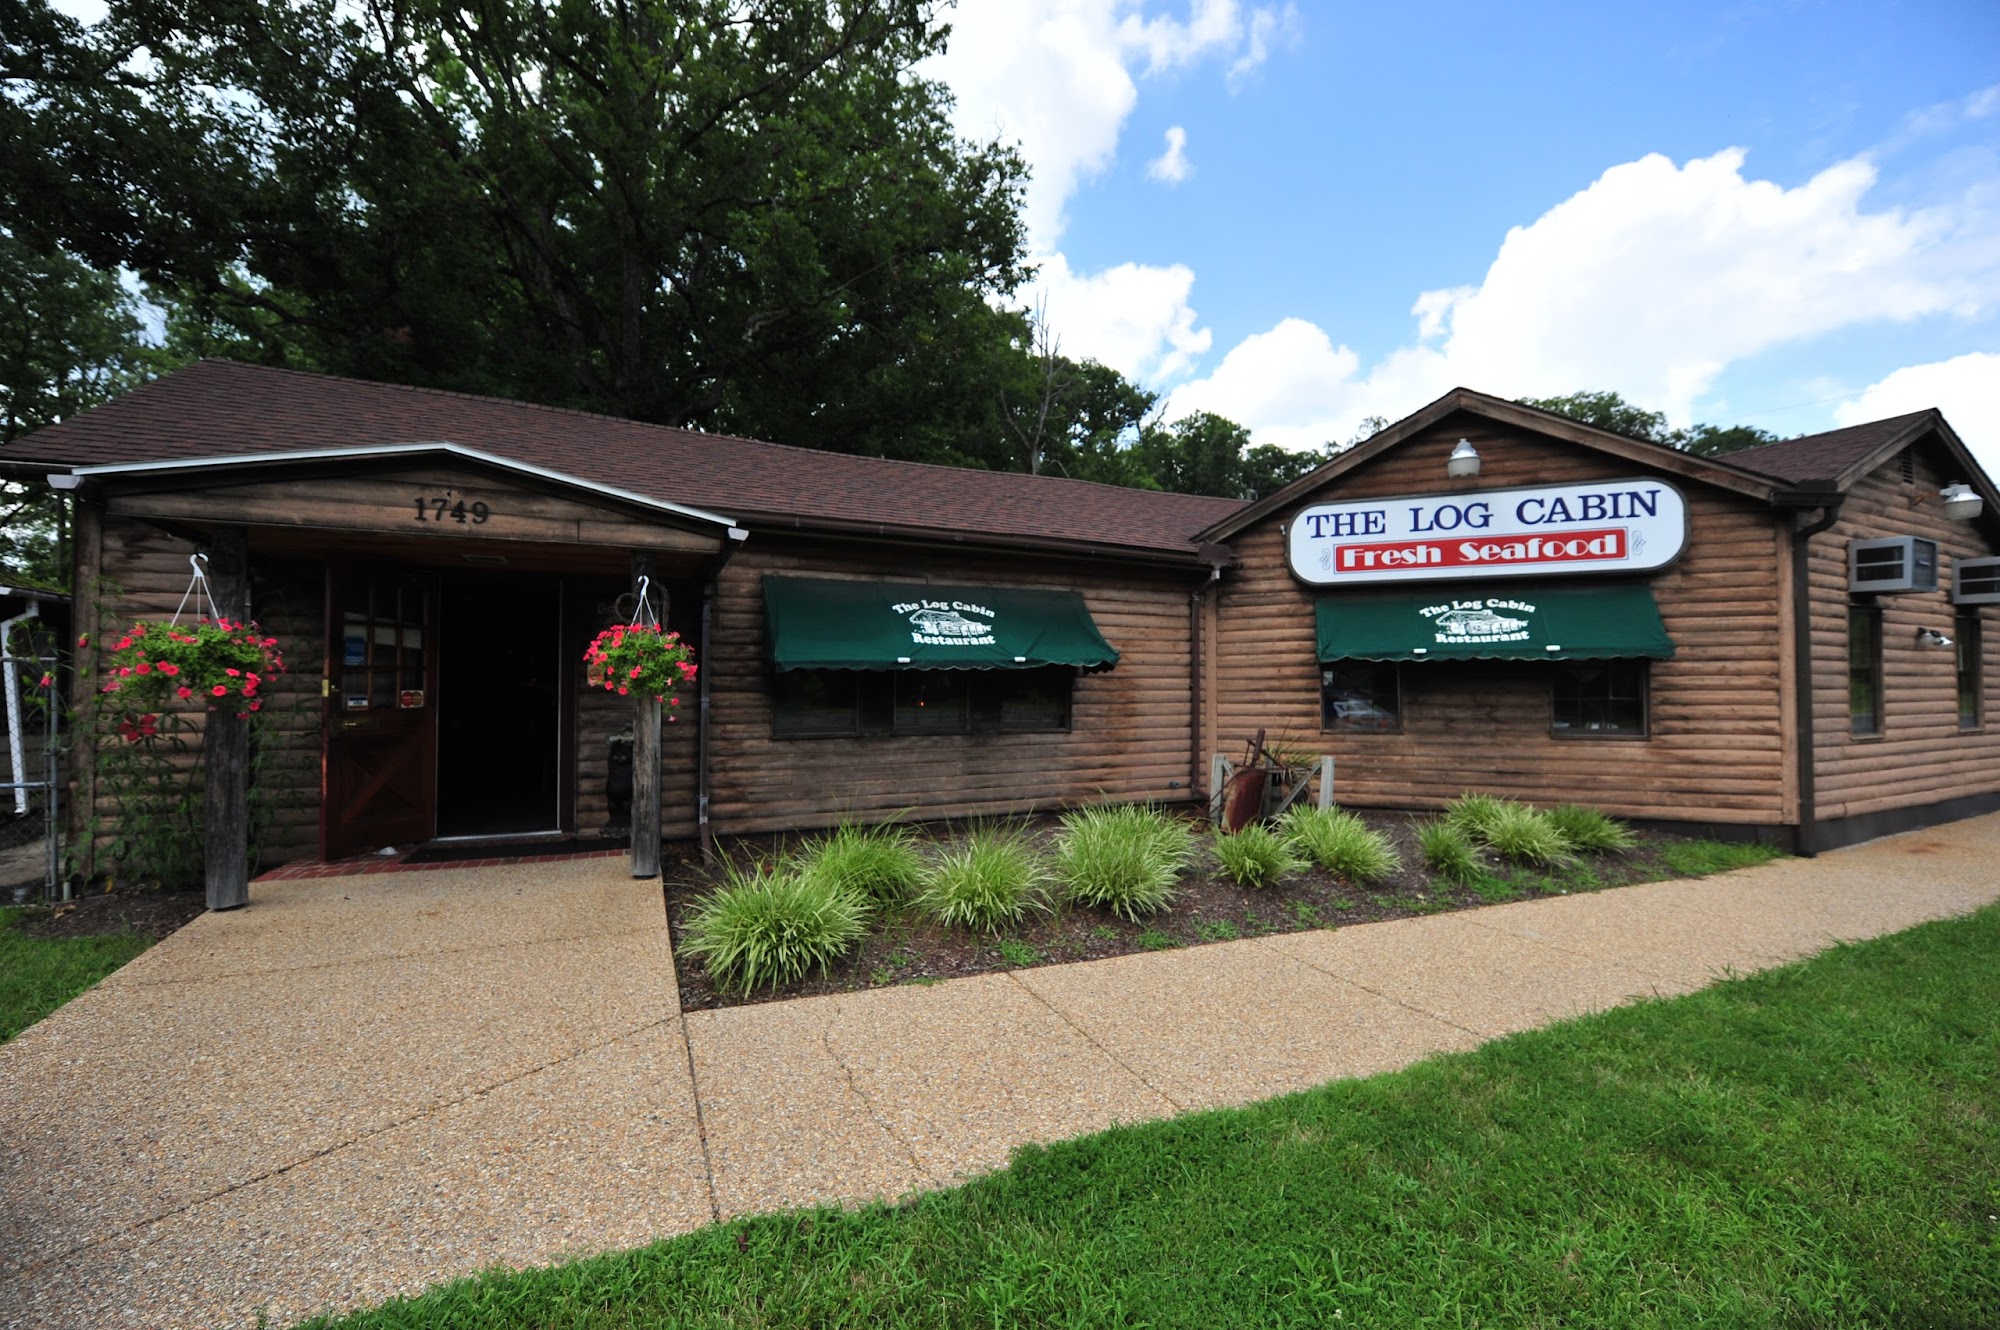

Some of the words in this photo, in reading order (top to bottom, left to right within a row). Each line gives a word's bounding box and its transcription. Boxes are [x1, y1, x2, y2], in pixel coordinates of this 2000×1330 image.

[414, 497, 490, 524] 1749
[1307, 510, 1386, 538] THE
[1409, 502, 1494, 531] LOG
[1516, 489, 1661, 525] CABIN
[1343, 544, 1441, 568] Fresh
[1459, 534, 1618, 562] Seafood
[892, 602, 920, 615] The
[921, 599, 949, 611] Log
[952, 600, 996, 618] Cabin
[1419, 604, 1450, 618] The
[1452, 600, 1483, 610] Log
[1486, 598, 1536, 614] Cabin
[911, 632, 996, 646] Restaurant
[1435, 630, 1530, 644] Restaurant
